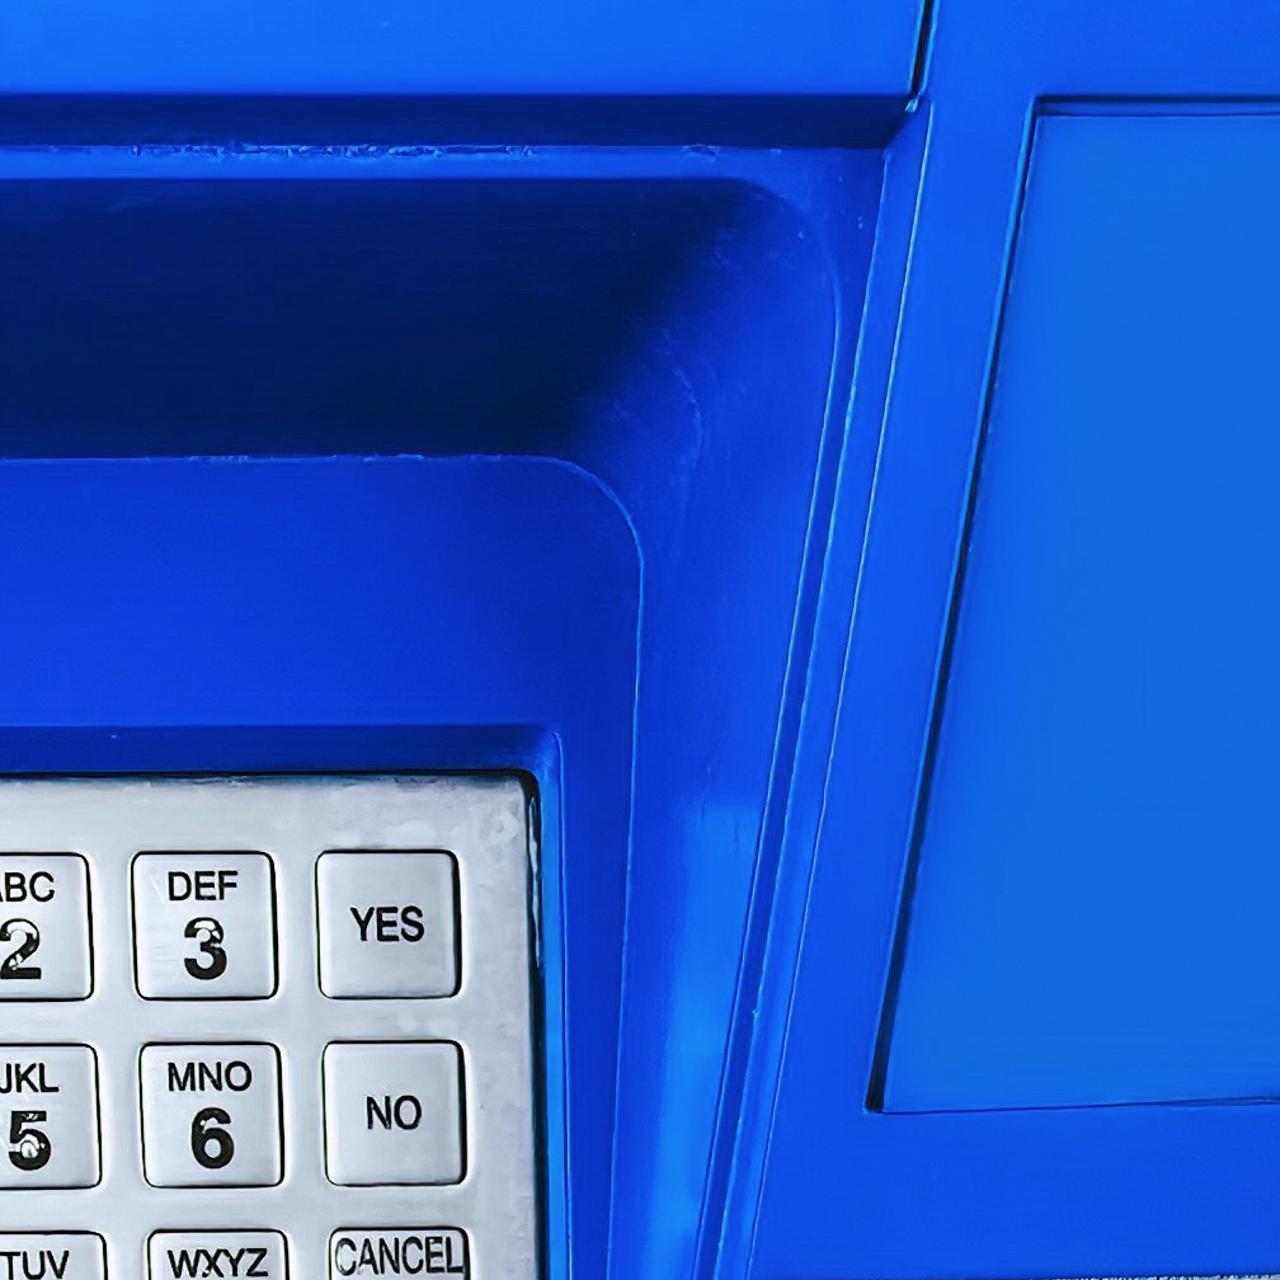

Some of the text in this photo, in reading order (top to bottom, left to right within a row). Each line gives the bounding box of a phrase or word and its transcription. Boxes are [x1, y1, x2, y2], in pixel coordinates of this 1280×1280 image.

[168, 870, 239, 901] DEF
[350, 905, 425, 943] YES
[183, 917, 227, 981] 3
[167, 1060, 253, 1092] MNO
[366, 1094, 422, 1131] NO
[8, 1110, 52, 1171] 5
[191, 1107, 235, 1169] 6
[0, 1250, 70, 1280] TUV
[167, 1247, 269, 1279] WXYZ
[334, 1236, 463, 1277] CANCEL
